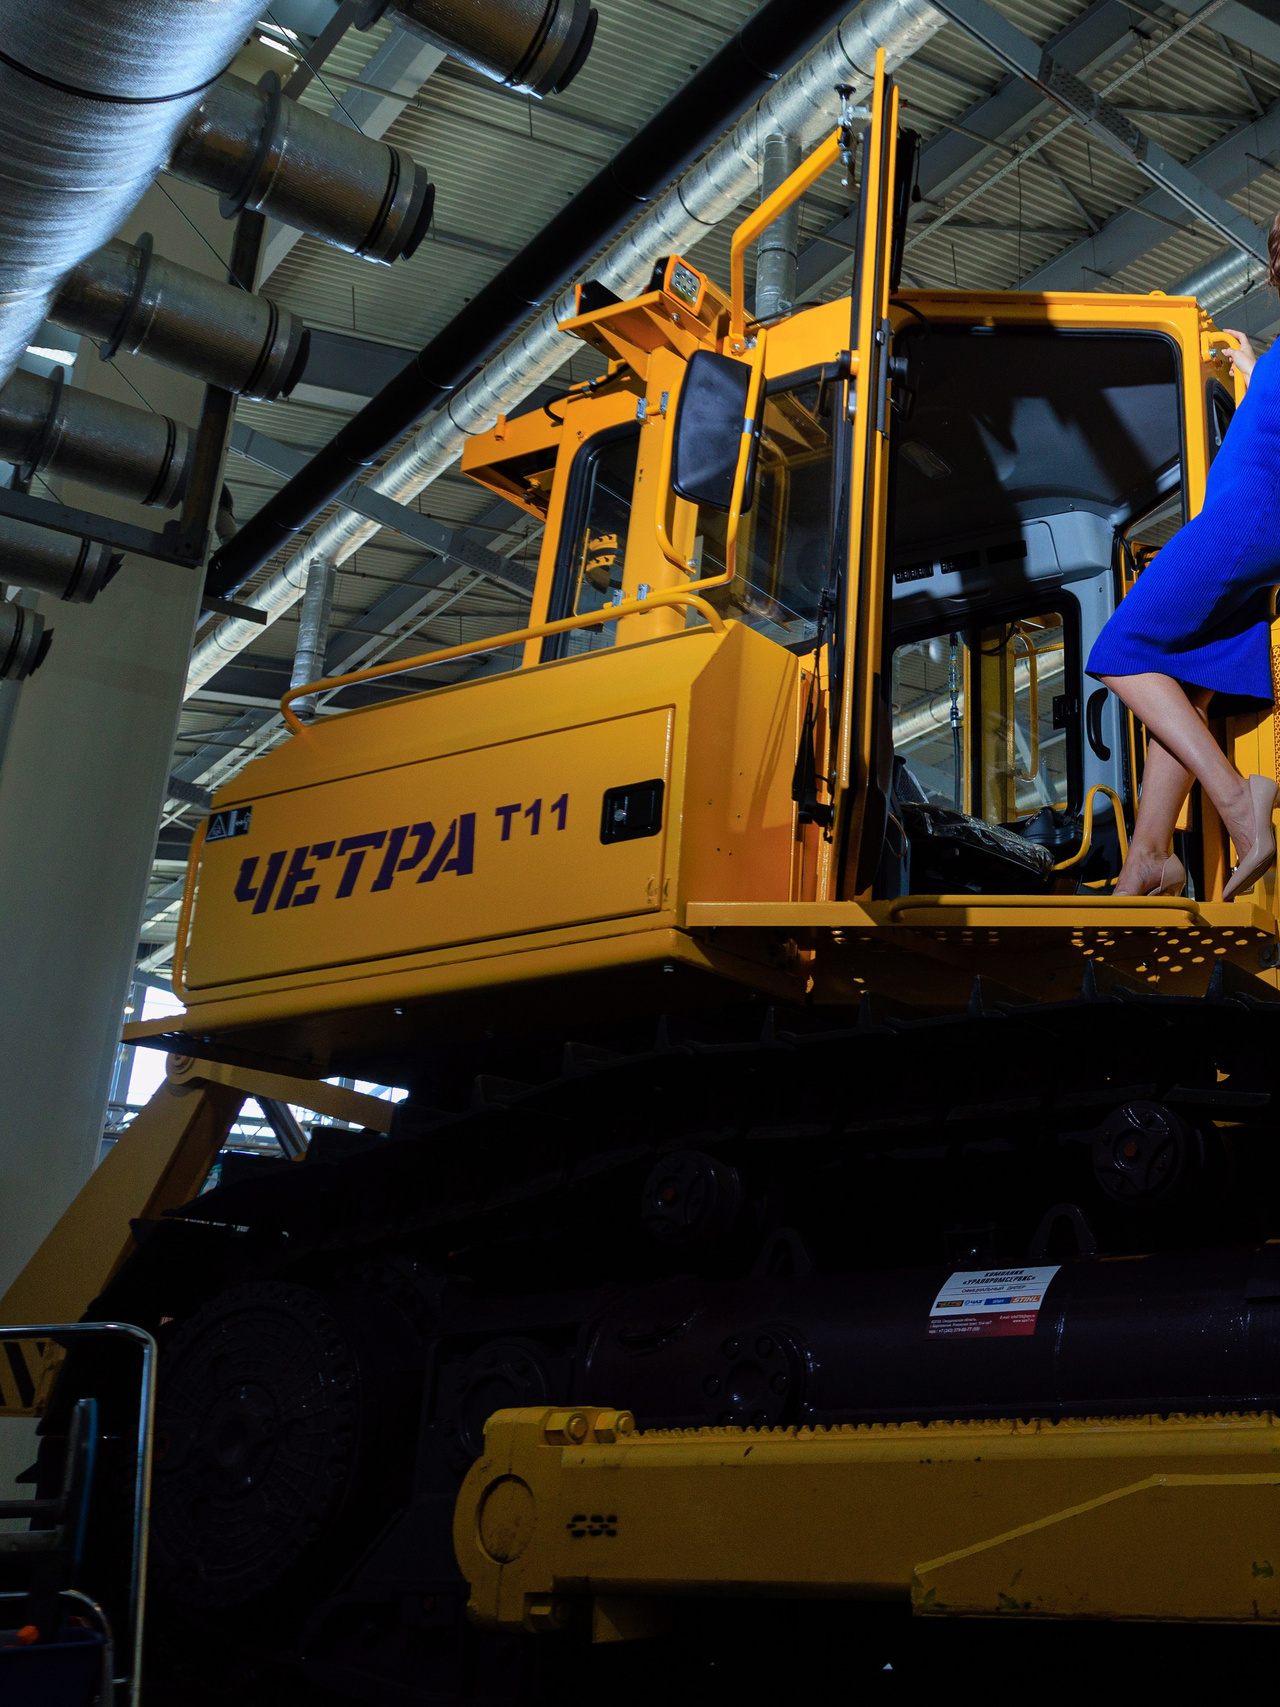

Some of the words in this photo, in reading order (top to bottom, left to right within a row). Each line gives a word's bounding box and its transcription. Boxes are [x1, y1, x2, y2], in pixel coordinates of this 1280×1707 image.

[233, 812, 476, 915] ЧЕТРА
[495, 793, 569, 841] Т11
[1012, 1295, 1039, 1303] STIHL
